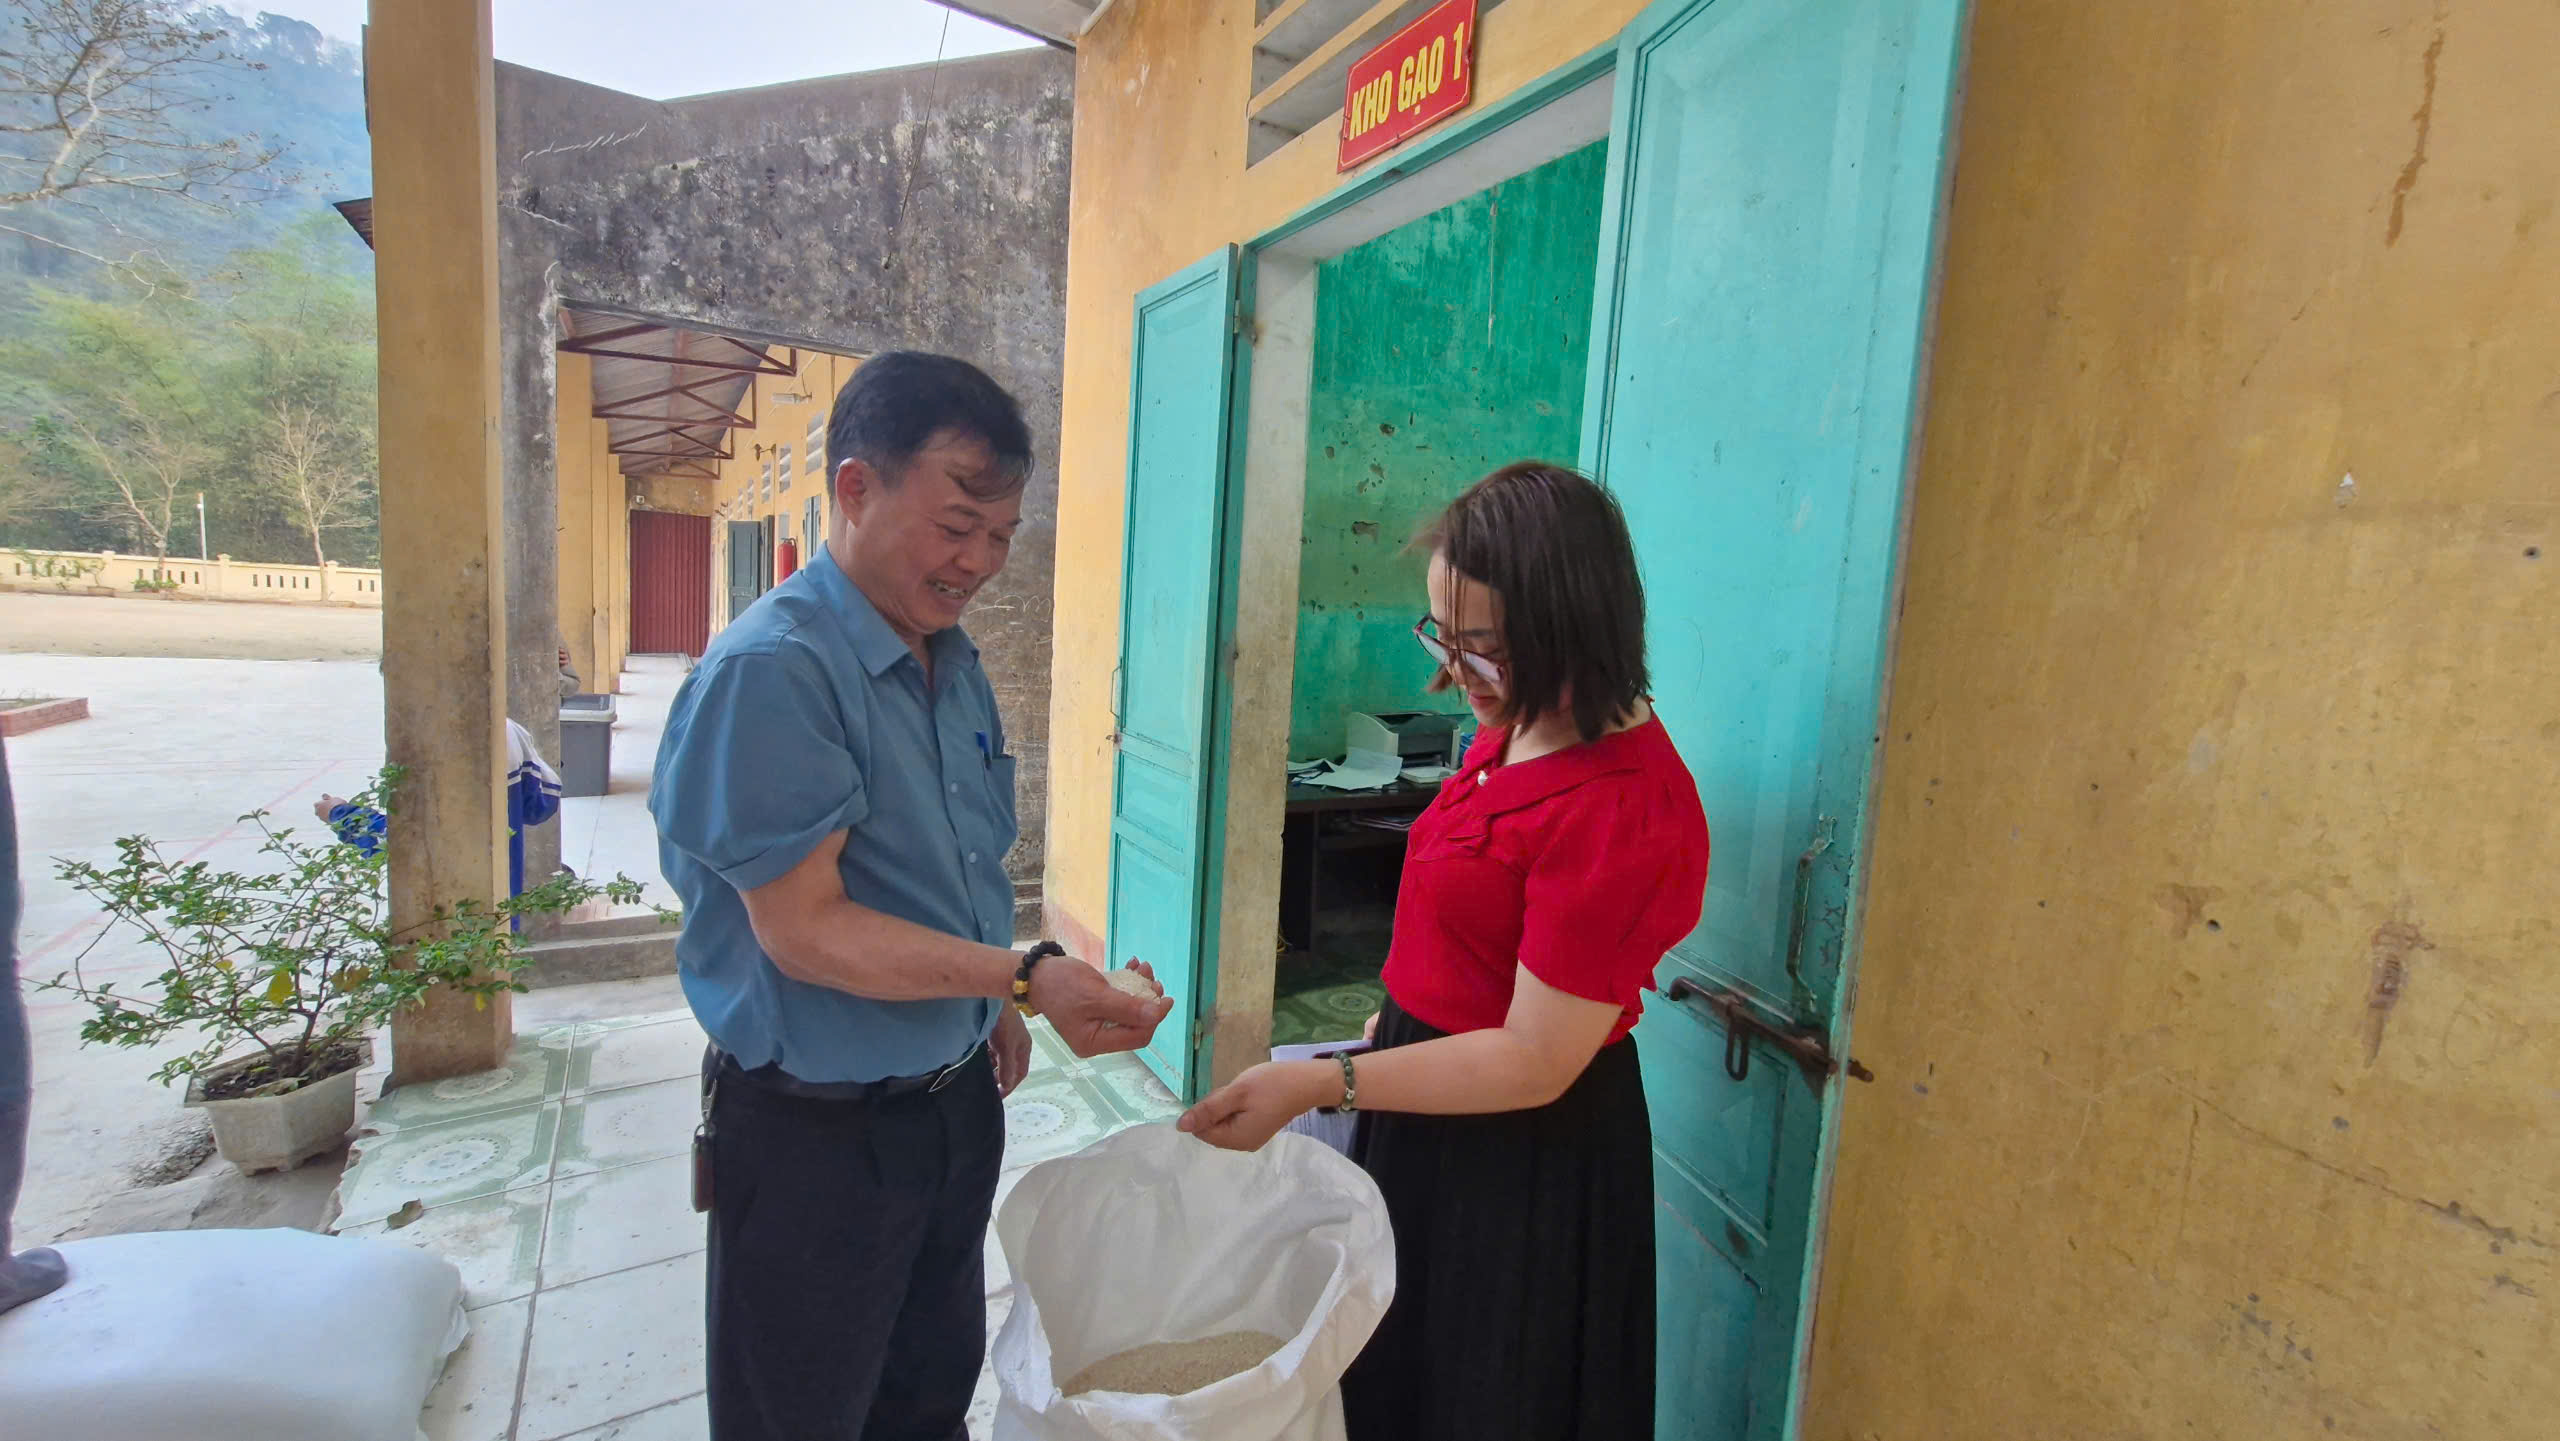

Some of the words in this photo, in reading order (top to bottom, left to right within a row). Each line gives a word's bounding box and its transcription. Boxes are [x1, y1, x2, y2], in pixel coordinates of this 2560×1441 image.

[1349, 70, 1393, 141] KHO
[1398, 35, 1445, 116] GẠO
[1453, 21, 1464, 81] 1
